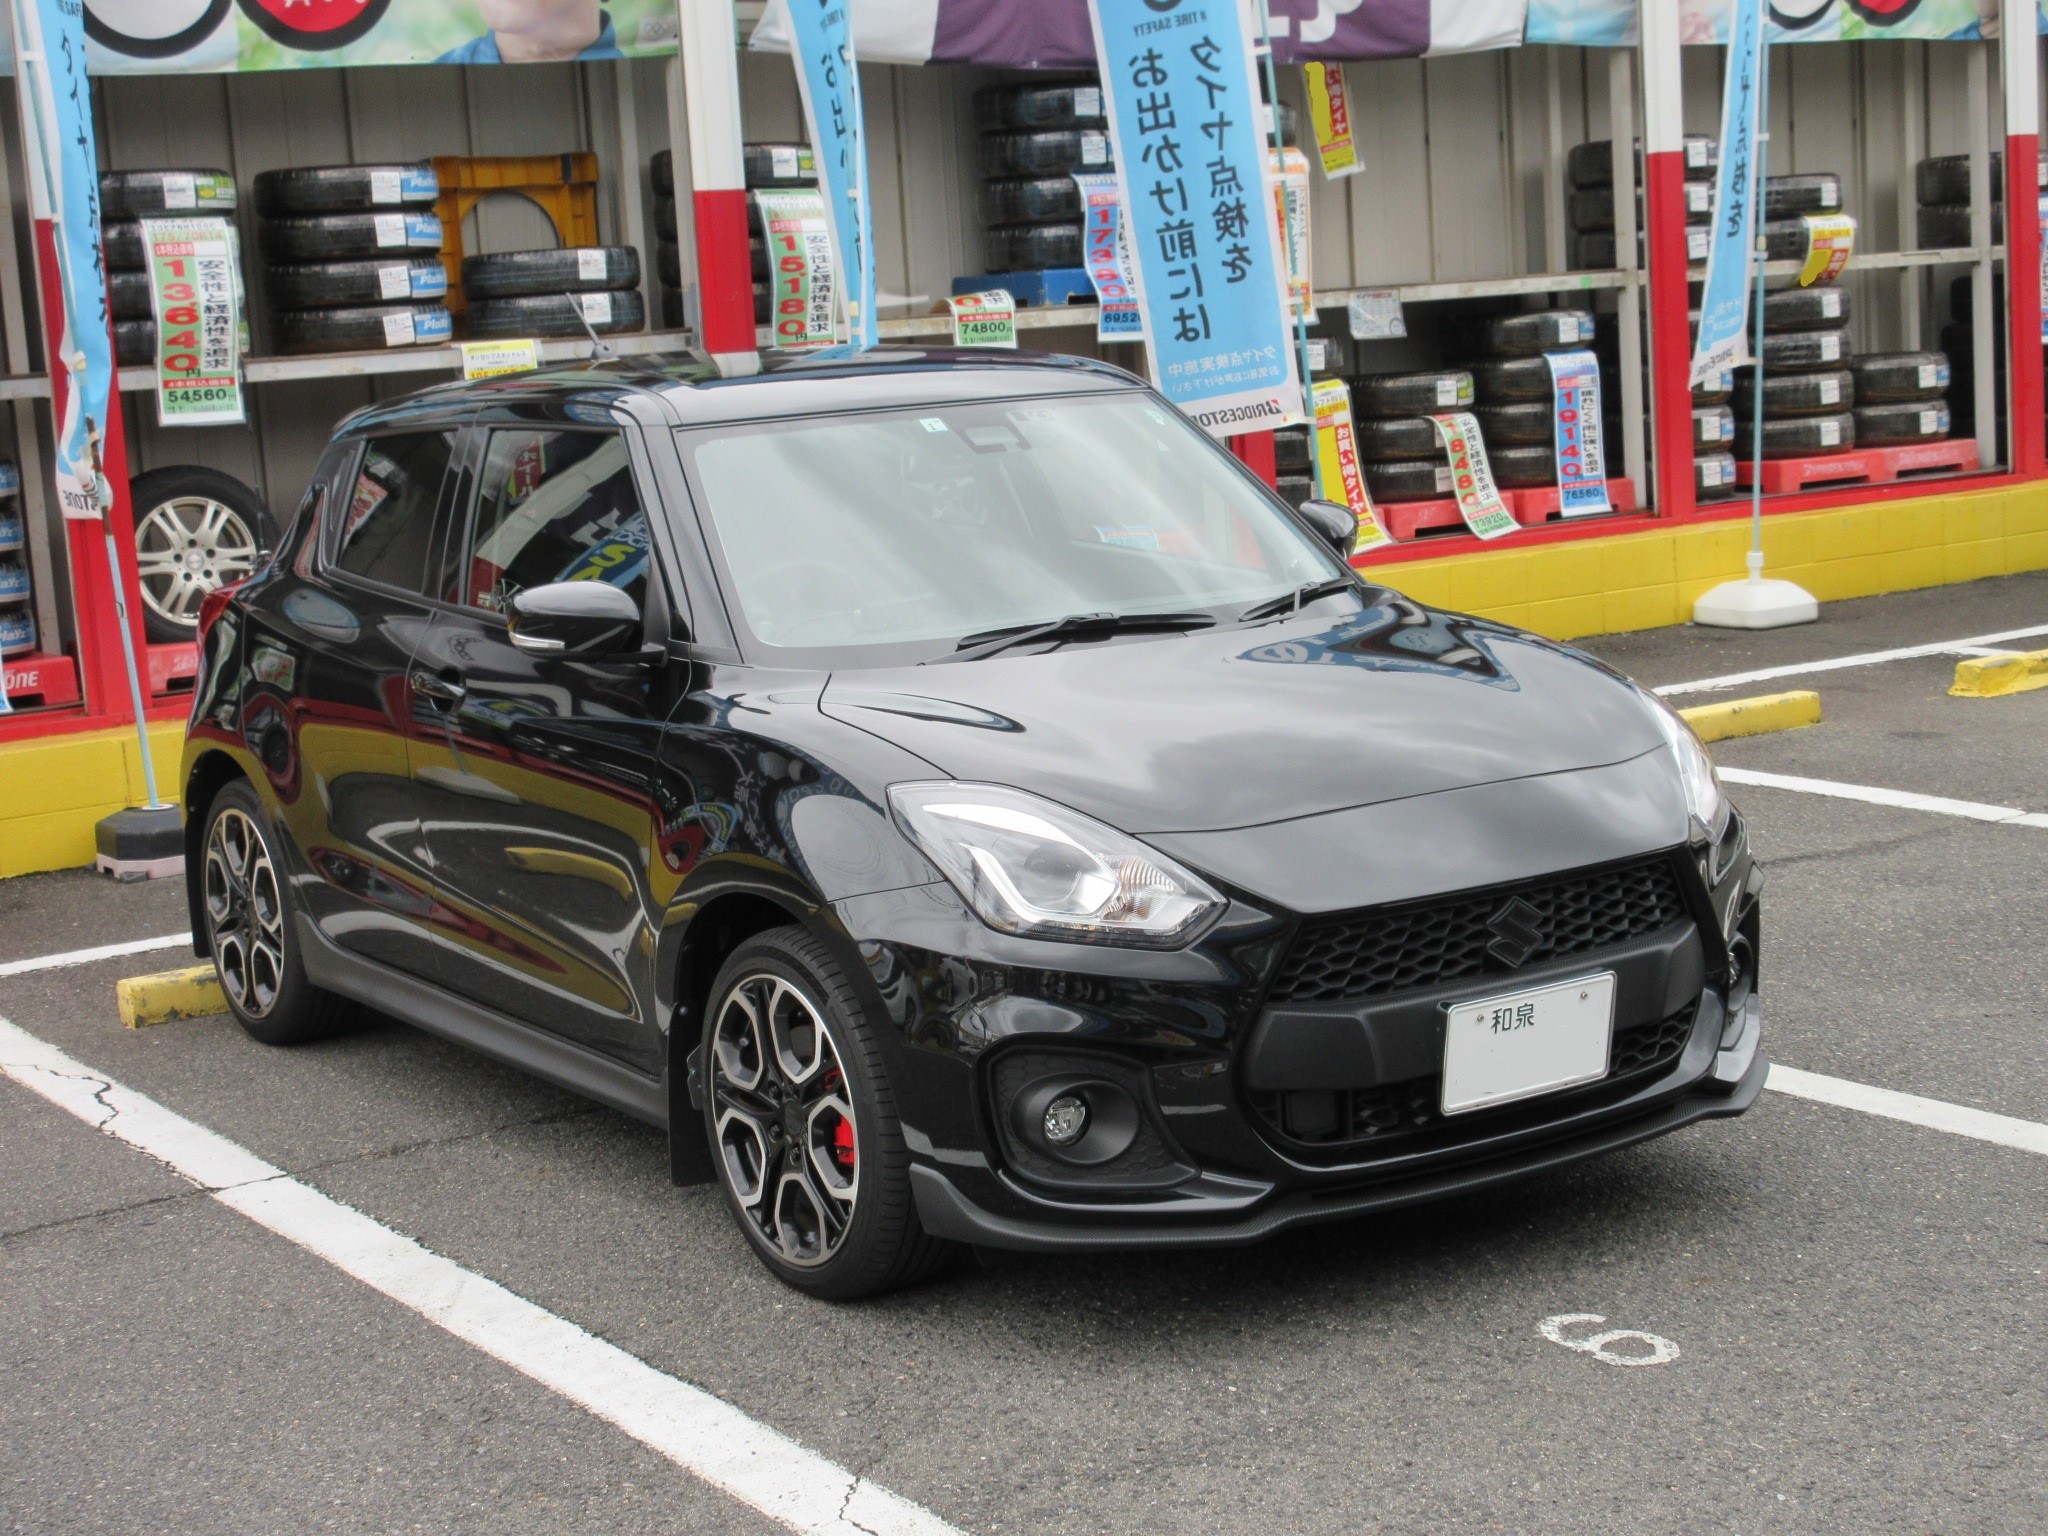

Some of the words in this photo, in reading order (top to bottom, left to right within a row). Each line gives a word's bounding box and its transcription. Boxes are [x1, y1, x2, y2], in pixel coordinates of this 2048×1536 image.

[198, 259, 233, 369] 安全性と経済性を追求
[806, 234, 832, 333] 安全性と経済性を追求
[1104, 312, 1141, 323] 69,52
[1336, 427, 1368, 514] お買い得タイヤ
[1490, 1003, 1535, 1034] 和泉
